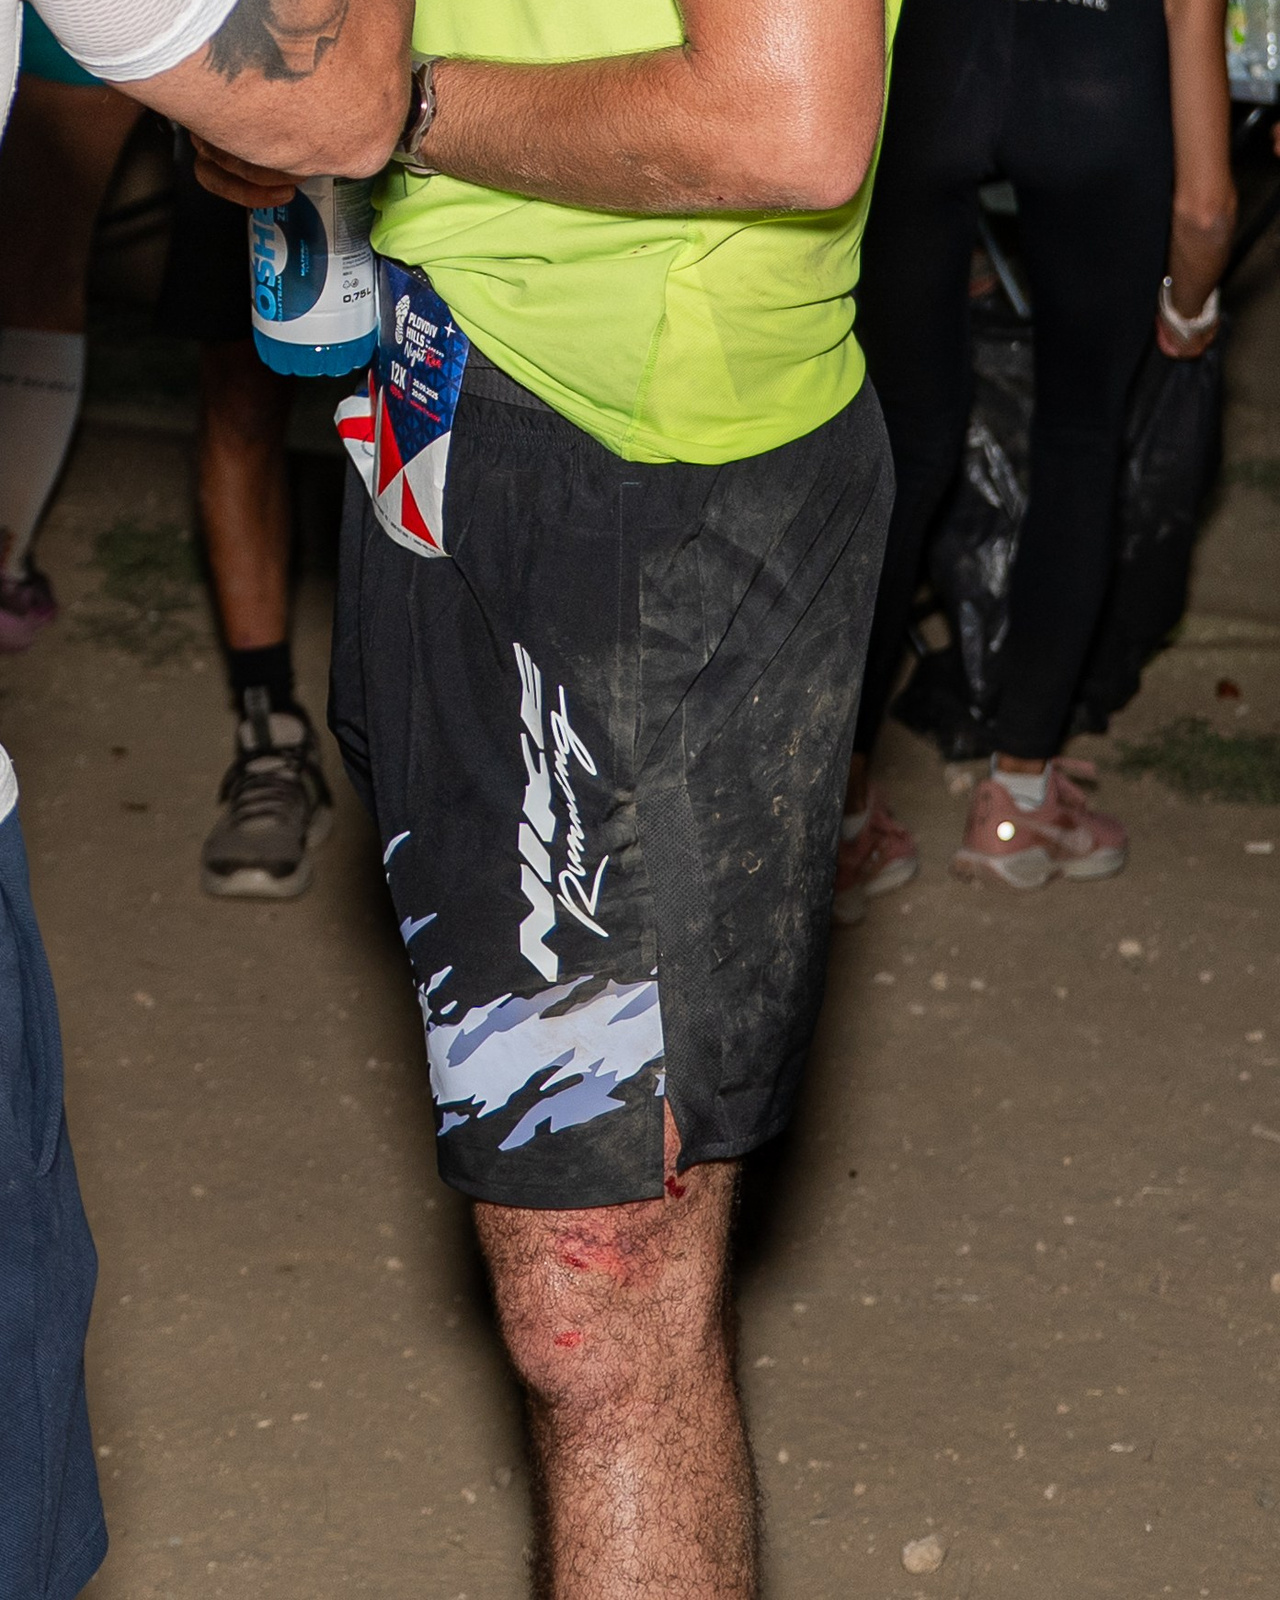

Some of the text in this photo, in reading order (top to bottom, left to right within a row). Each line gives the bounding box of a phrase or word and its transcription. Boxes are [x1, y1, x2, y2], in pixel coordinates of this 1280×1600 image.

[252, 206, 277, 321] OSHE
[405, 325, 426, 347] HILLS
[407, 311, 439, 339] PLOVDIV
[404, 341, 427, 367] Night
[390, 360, 408, 391] 12K
[549, 685, 609, 938] Running
